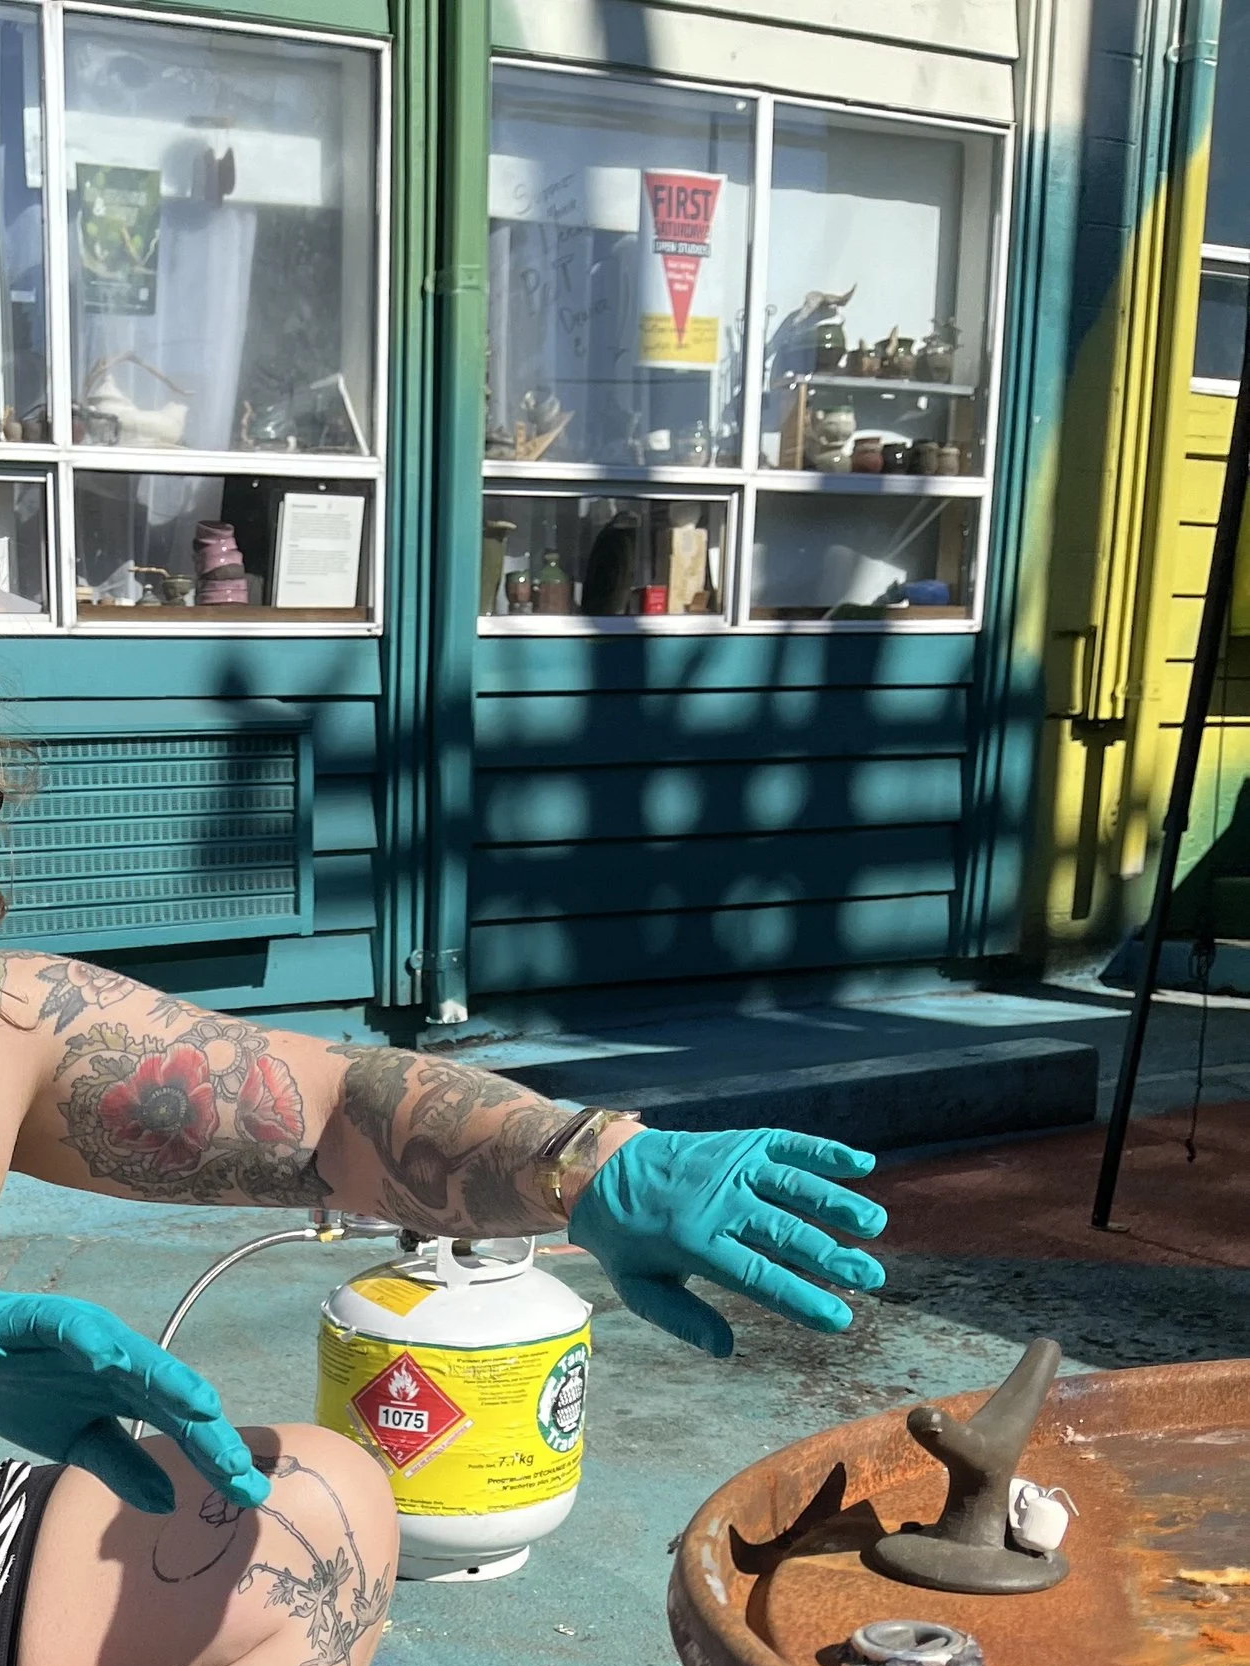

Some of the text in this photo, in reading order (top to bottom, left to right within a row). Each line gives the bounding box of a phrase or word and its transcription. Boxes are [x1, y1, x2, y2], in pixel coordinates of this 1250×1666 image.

[653, 184, 712, 221] FIRST
[558, 1345, 586, 1373] Tank
[382, 1408, 425, 1430] 1075
[397, 1451, 404, 1461] 2
